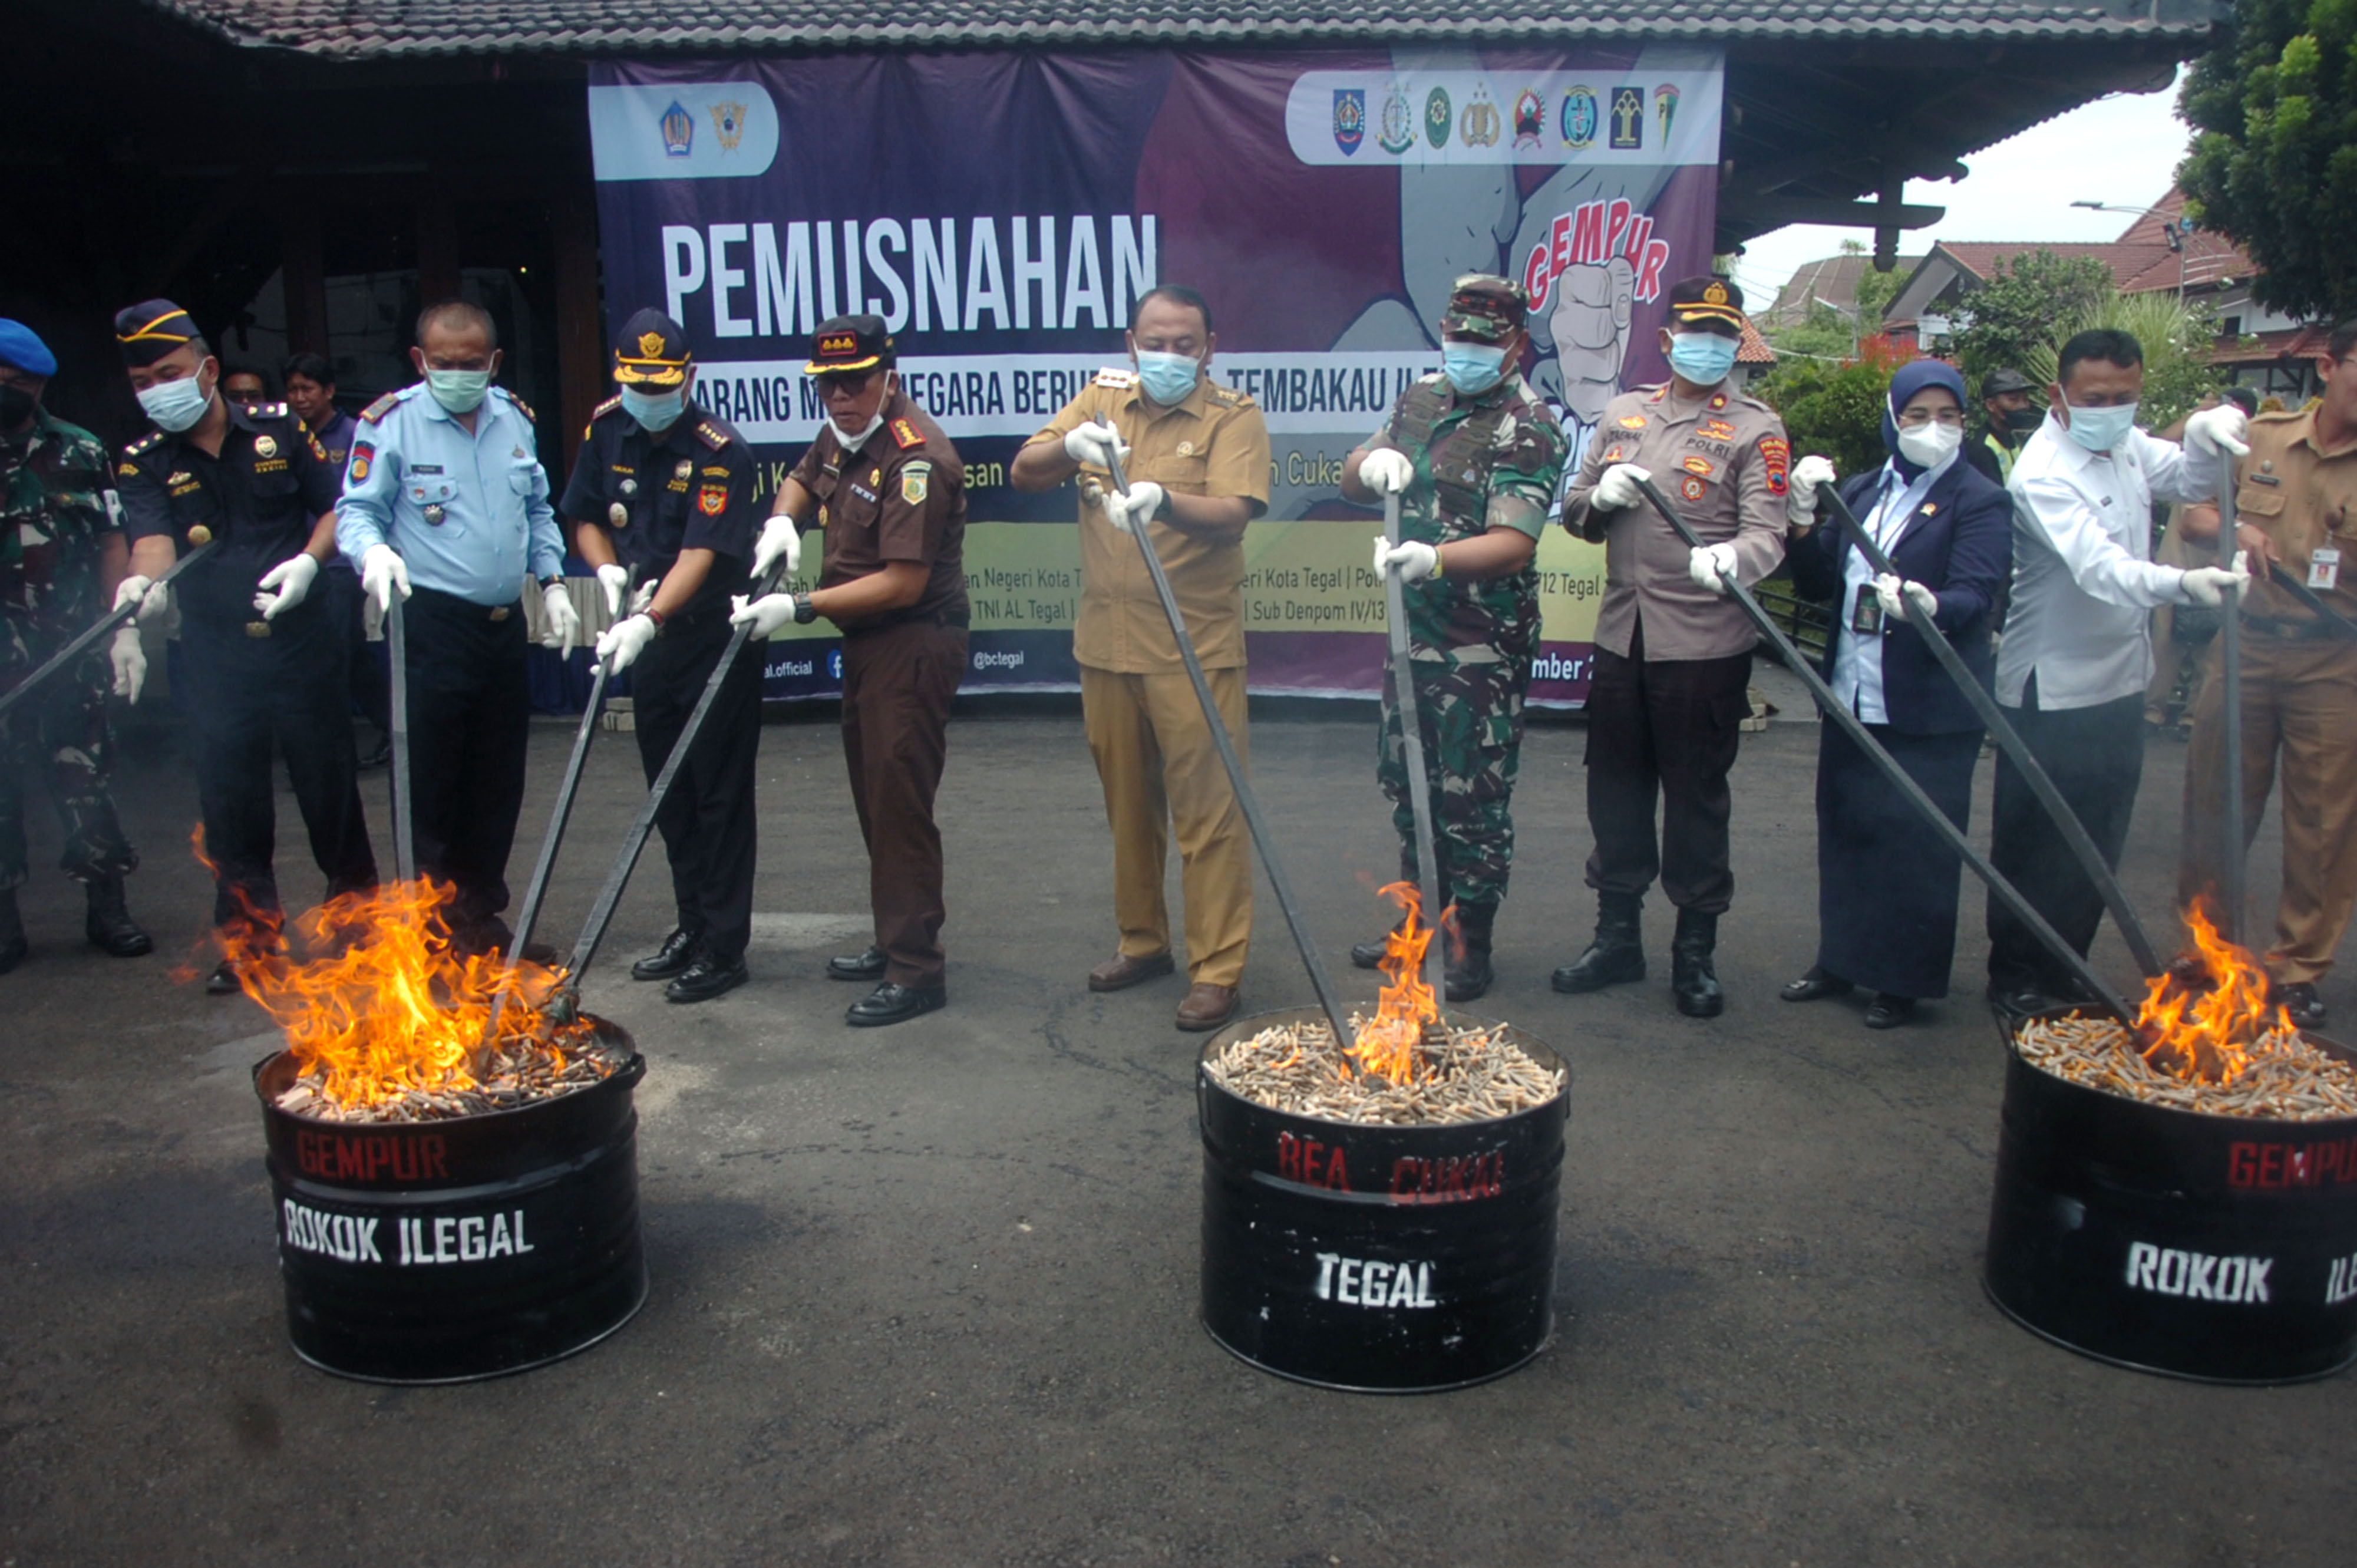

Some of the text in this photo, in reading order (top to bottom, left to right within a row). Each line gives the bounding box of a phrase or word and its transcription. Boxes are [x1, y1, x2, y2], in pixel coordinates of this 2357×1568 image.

[662, 214, 1157, 338] PEMUSNAHAN
[1524, 197, 1669, 315] GEMPUR
[1227, 368, 1386, 413] TEMBAKAU
[1288, 451, 1351, 486] Cuka
[1686, 438, 1731, 458] POLRI
[985, 567, 1032, 592] Negeri
[1037, 569, 1070, 587] Kota
[1266, 568, 1298, 588] Kota
[1303, 567, 1341, 592] Tegal
[1561, 573, 1599, 600] Tegal
[976, 600, 1000, 620] TNI
[1005, 599, 1024, 619] AL
[1028, 599, 1066, 623] Tegal
[1253, 600, 1280, 619] Sub
[1286, 600, 1346, 624] Denpom
[973, 651, 1025, 669] @bctegal
[298, 1130, 450, 1181] GEMPUR
[2228, 1138, 2357, 1188] GEMPU
[283, 1198, 535, 1266] ROKOK ILEGAL
[1315, 1253, 1436, 1308] TEGAL
[2127, 1240, 2273, 1303] ROKOK
